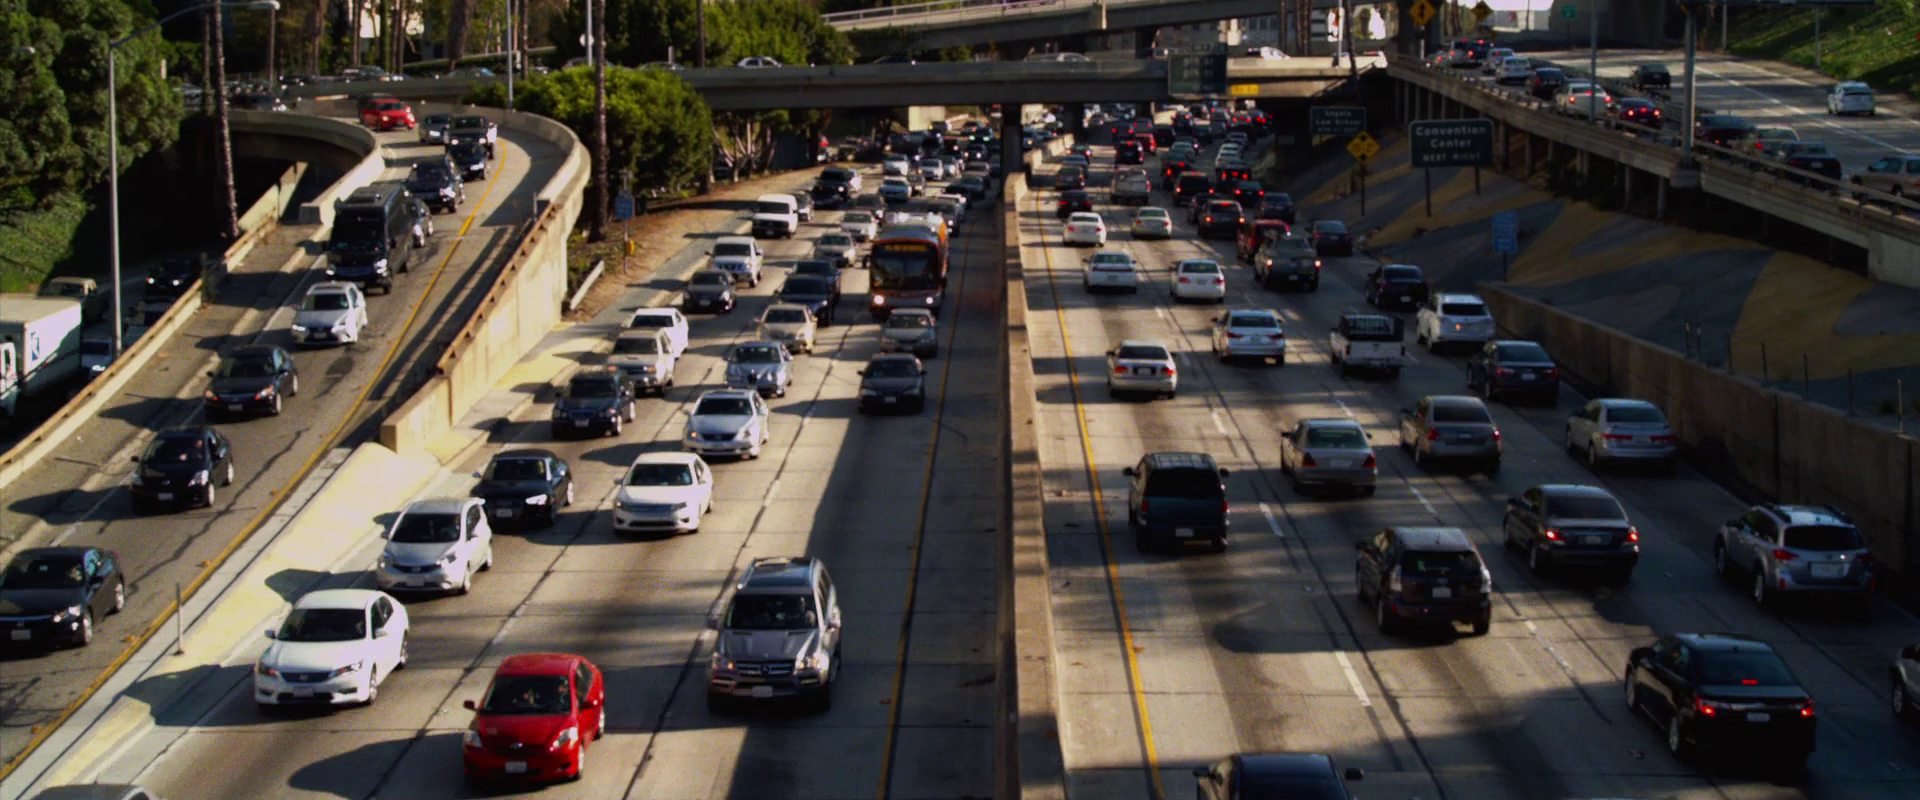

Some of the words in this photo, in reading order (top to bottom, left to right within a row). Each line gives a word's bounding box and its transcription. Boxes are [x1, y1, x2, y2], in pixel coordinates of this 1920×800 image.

[1415, 125, 1487, 136] Convention
[1430, 138, 1472, 148] Center
[1423, 153, 1447, 162] NEXT
